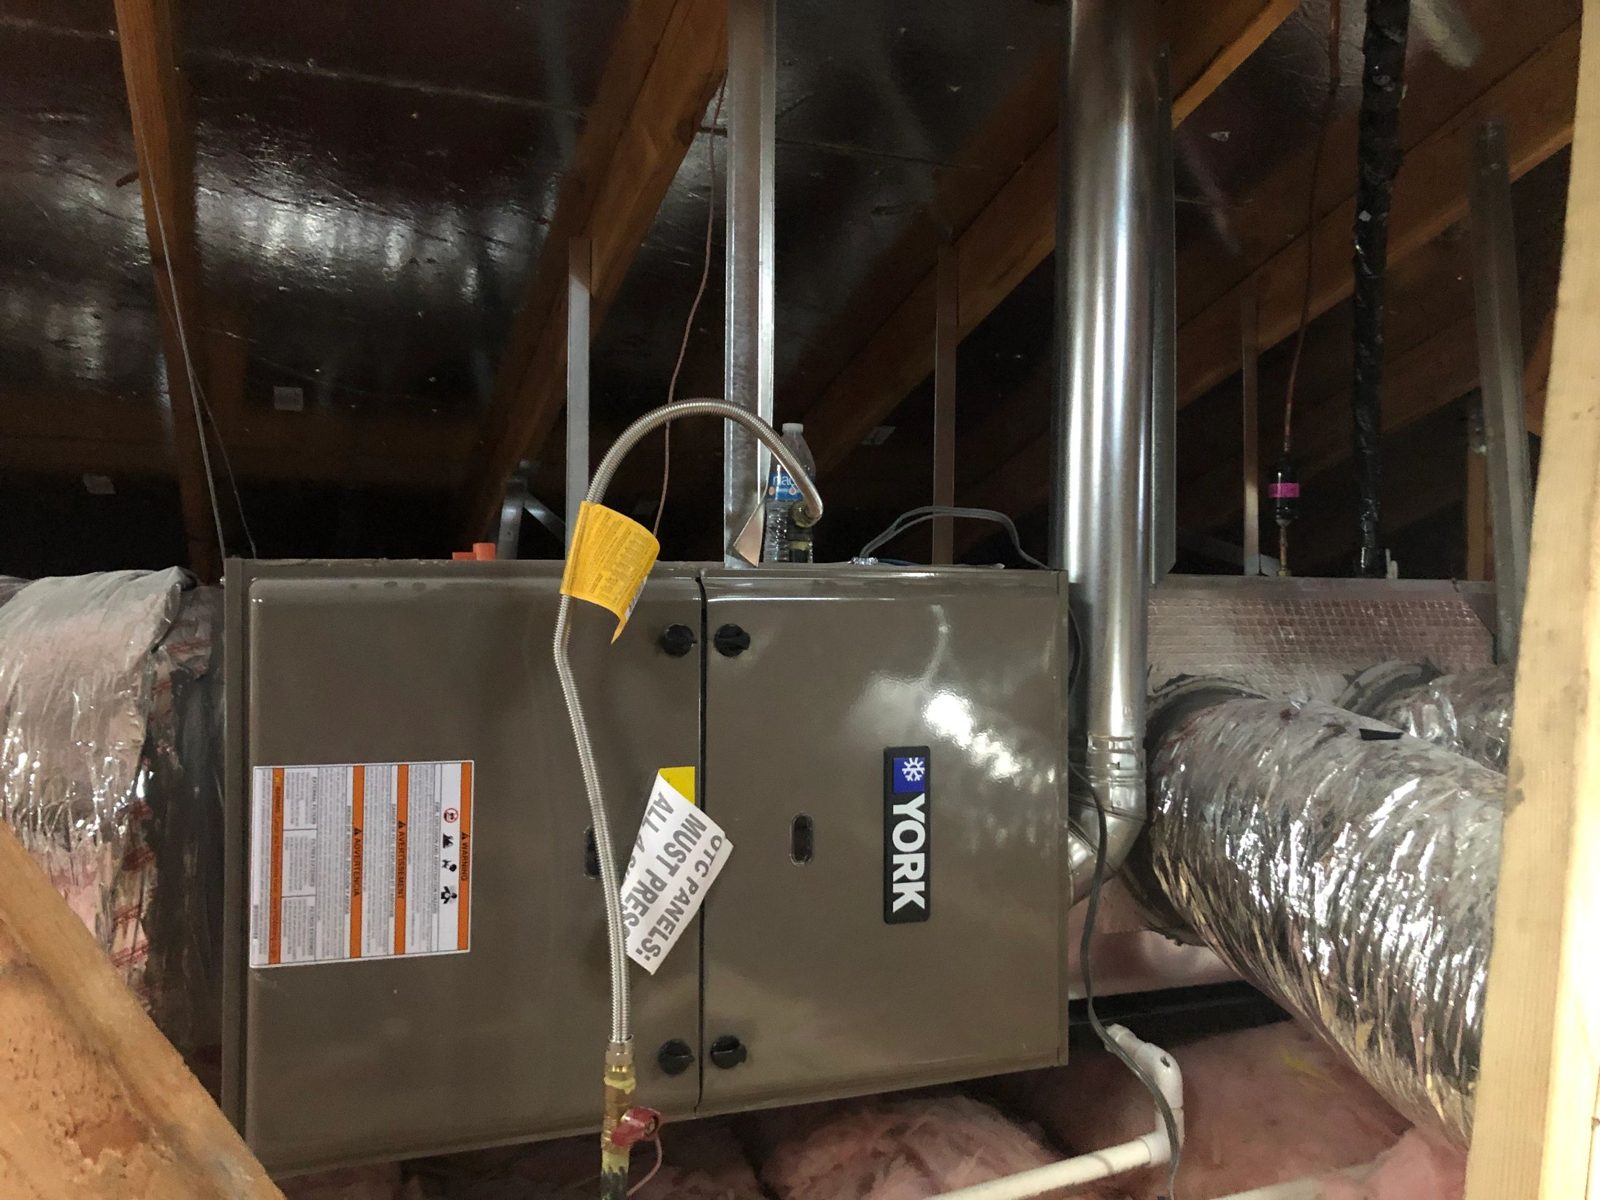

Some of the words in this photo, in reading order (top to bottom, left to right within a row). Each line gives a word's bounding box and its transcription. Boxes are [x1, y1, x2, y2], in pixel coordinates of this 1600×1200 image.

[642, 792, 674, 832] ALL
[353, 836, 361, 897] ADVERTENCIA
[398, 831, 406, 899] AVERTISSEMENT
[461, 843, 469, 881] WARNING
[656, 813, 707, 877] MUST
[892, 793, 926, 913] YORK
[635, 877, 699, 961] PANELS:
